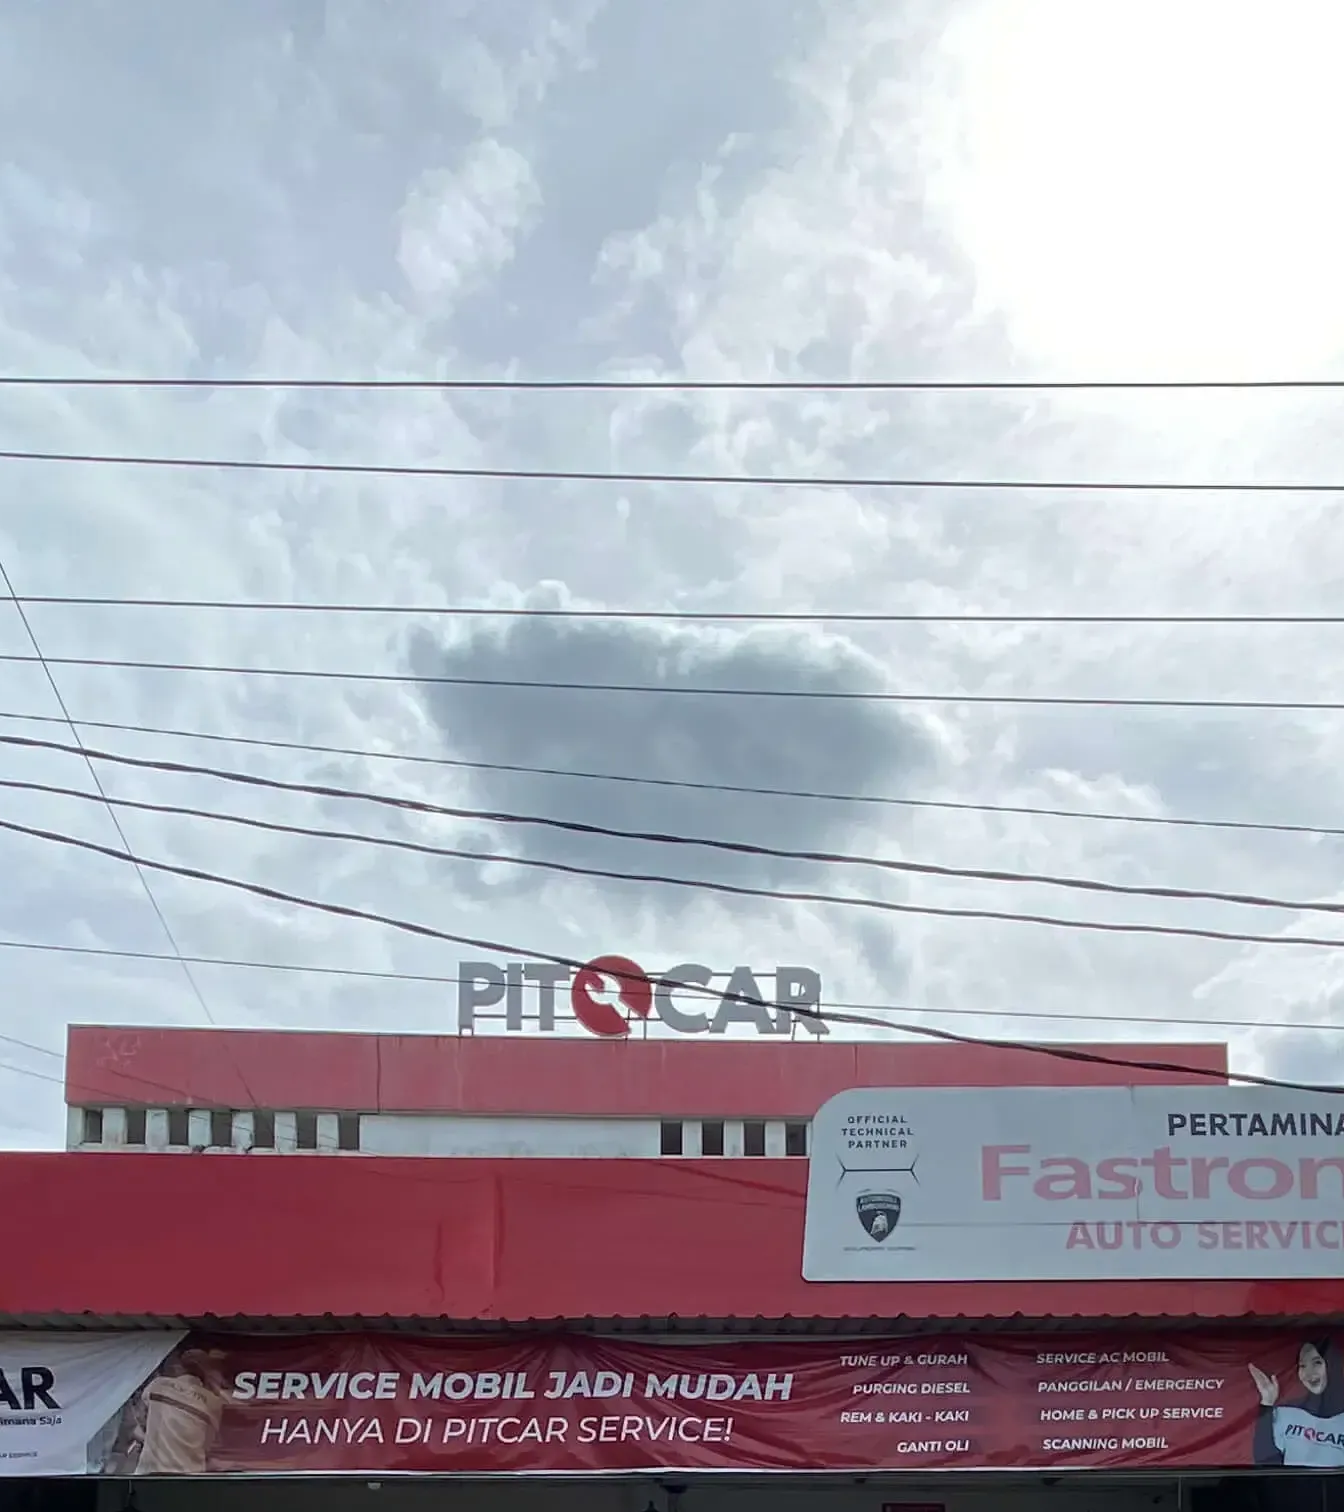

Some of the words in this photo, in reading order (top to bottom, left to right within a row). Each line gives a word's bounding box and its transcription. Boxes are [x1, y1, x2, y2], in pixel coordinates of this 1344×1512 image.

[847, 1115, 909, 1124] OFFICIAL
[841, 1127, 915, 1137] TECHNICAL
[848, 1139, 908, 1149] PARTNER
[1065, 1220, 1180, 1250] AUTO
[840, 1355, 877, 1368] TUNE
[880, 1355, 901, 1368] UP
[903, 1355, 914, 1367] &
[917, 1354, 968, 1367] GURAH
[1036, 1352, 1096, 1365] SERVICE
[1098, 1352, 1120, 1364] AC
[1123, 1351, 1170, 1363] MOBIL
[231, 1371, 400, 1401] SERVICE
[408, 1372, 536, 1400] MOBIL
[544, 1371, 635, 1399] JADI
[643, 1373, 793, 1402] MUDAH
[853, 1383, 918, 1395] PURGING
[921, 1382, 970, 1394] DIESEL
[1038, 1380, 1122, 1393] PANGGILAN
[1124, 1379, 1132, 1393] /
[1135, 1378, 1224, 1391] EMERGENCY
[39, 1416, 62, 1426] Saja
[840, 1411, 872, 1424] REM
[874, 1411, 885, 1424] &
[888, 1410, 923, 1424] KAKI
[935, 1409, 969, 1423] KAKI
[1040, 1408, 1085, 1421] HOME
[1088, 1408, 1098, 1420] &
[1101, 1408, 1137, 1420] PICK
[1140, 1408, 1160, 1420] UP
[1163, 1407, 1223, 1420] SERVICE
[260, 1417, 384, 1446] HANYA
[396, 1417, 434, 1445] DI
[443, 1416, 569, 1444] PITCAR
[577, 1415, 734, 1443] SERVICE!
[897, 1440, 942, 1454] GANTI
[945, 1439, 969, 1453] OLI
[1042, 1437, 1118, 1451] SCANNING
[1121, 1436, 1169, 1449] MOBIL
